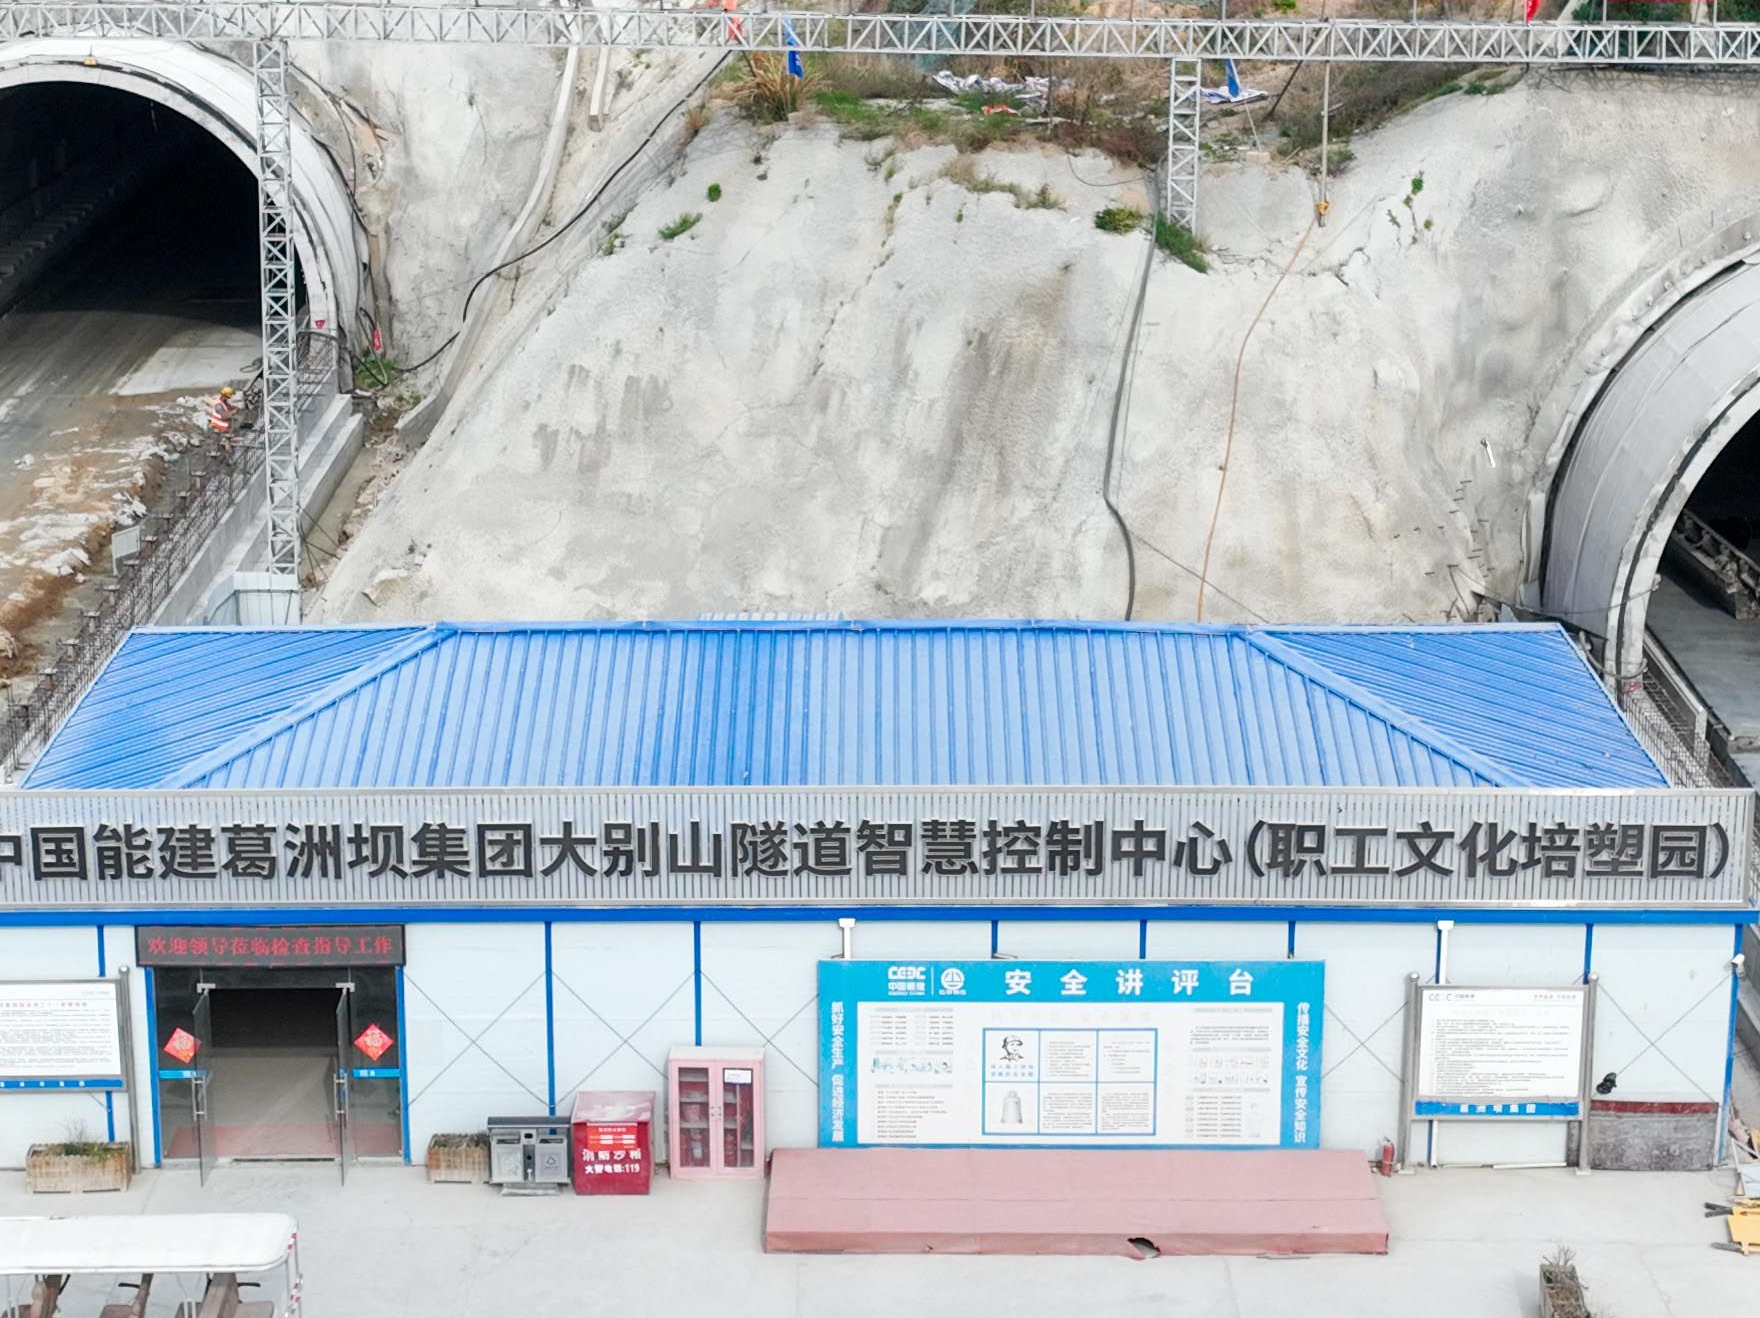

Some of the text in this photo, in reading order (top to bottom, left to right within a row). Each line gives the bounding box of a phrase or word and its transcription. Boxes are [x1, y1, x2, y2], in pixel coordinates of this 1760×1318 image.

[148, 936, 392, 956] 欢迎领导莅临检查指导工作
[1005, 969, 1254, 996] 安全讲评台
